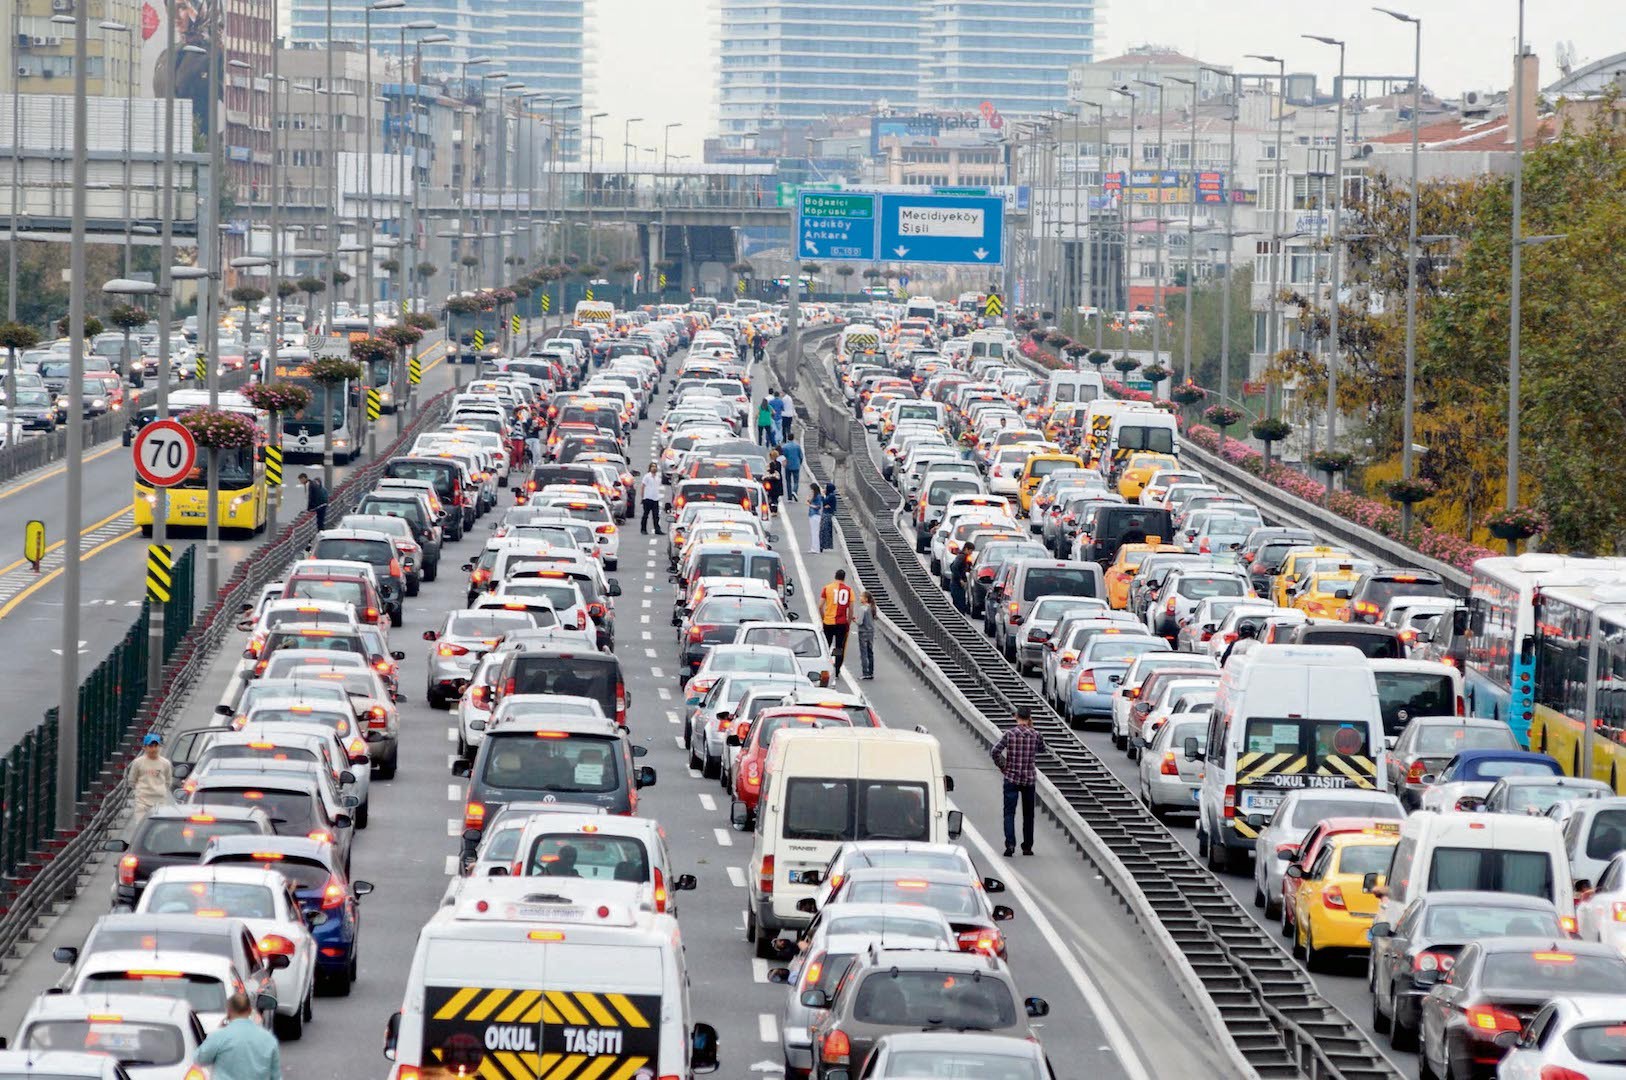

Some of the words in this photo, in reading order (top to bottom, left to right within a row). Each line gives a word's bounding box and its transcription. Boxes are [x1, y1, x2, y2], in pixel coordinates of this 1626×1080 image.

[902, 210, 978, 224] Mecidiyeköy
[804, 230, 848, 240] Ankara
[150, 439, 182, 469] 70
[833, 589, 849, 606] 10
[1275, 775, 1305, 787] OKUL
[1308, 777, 1345, 788] TAŞITI
[484, 1025, 536, 1051] OKUL
[563, 1028, 623, 1057] TAŞITI
